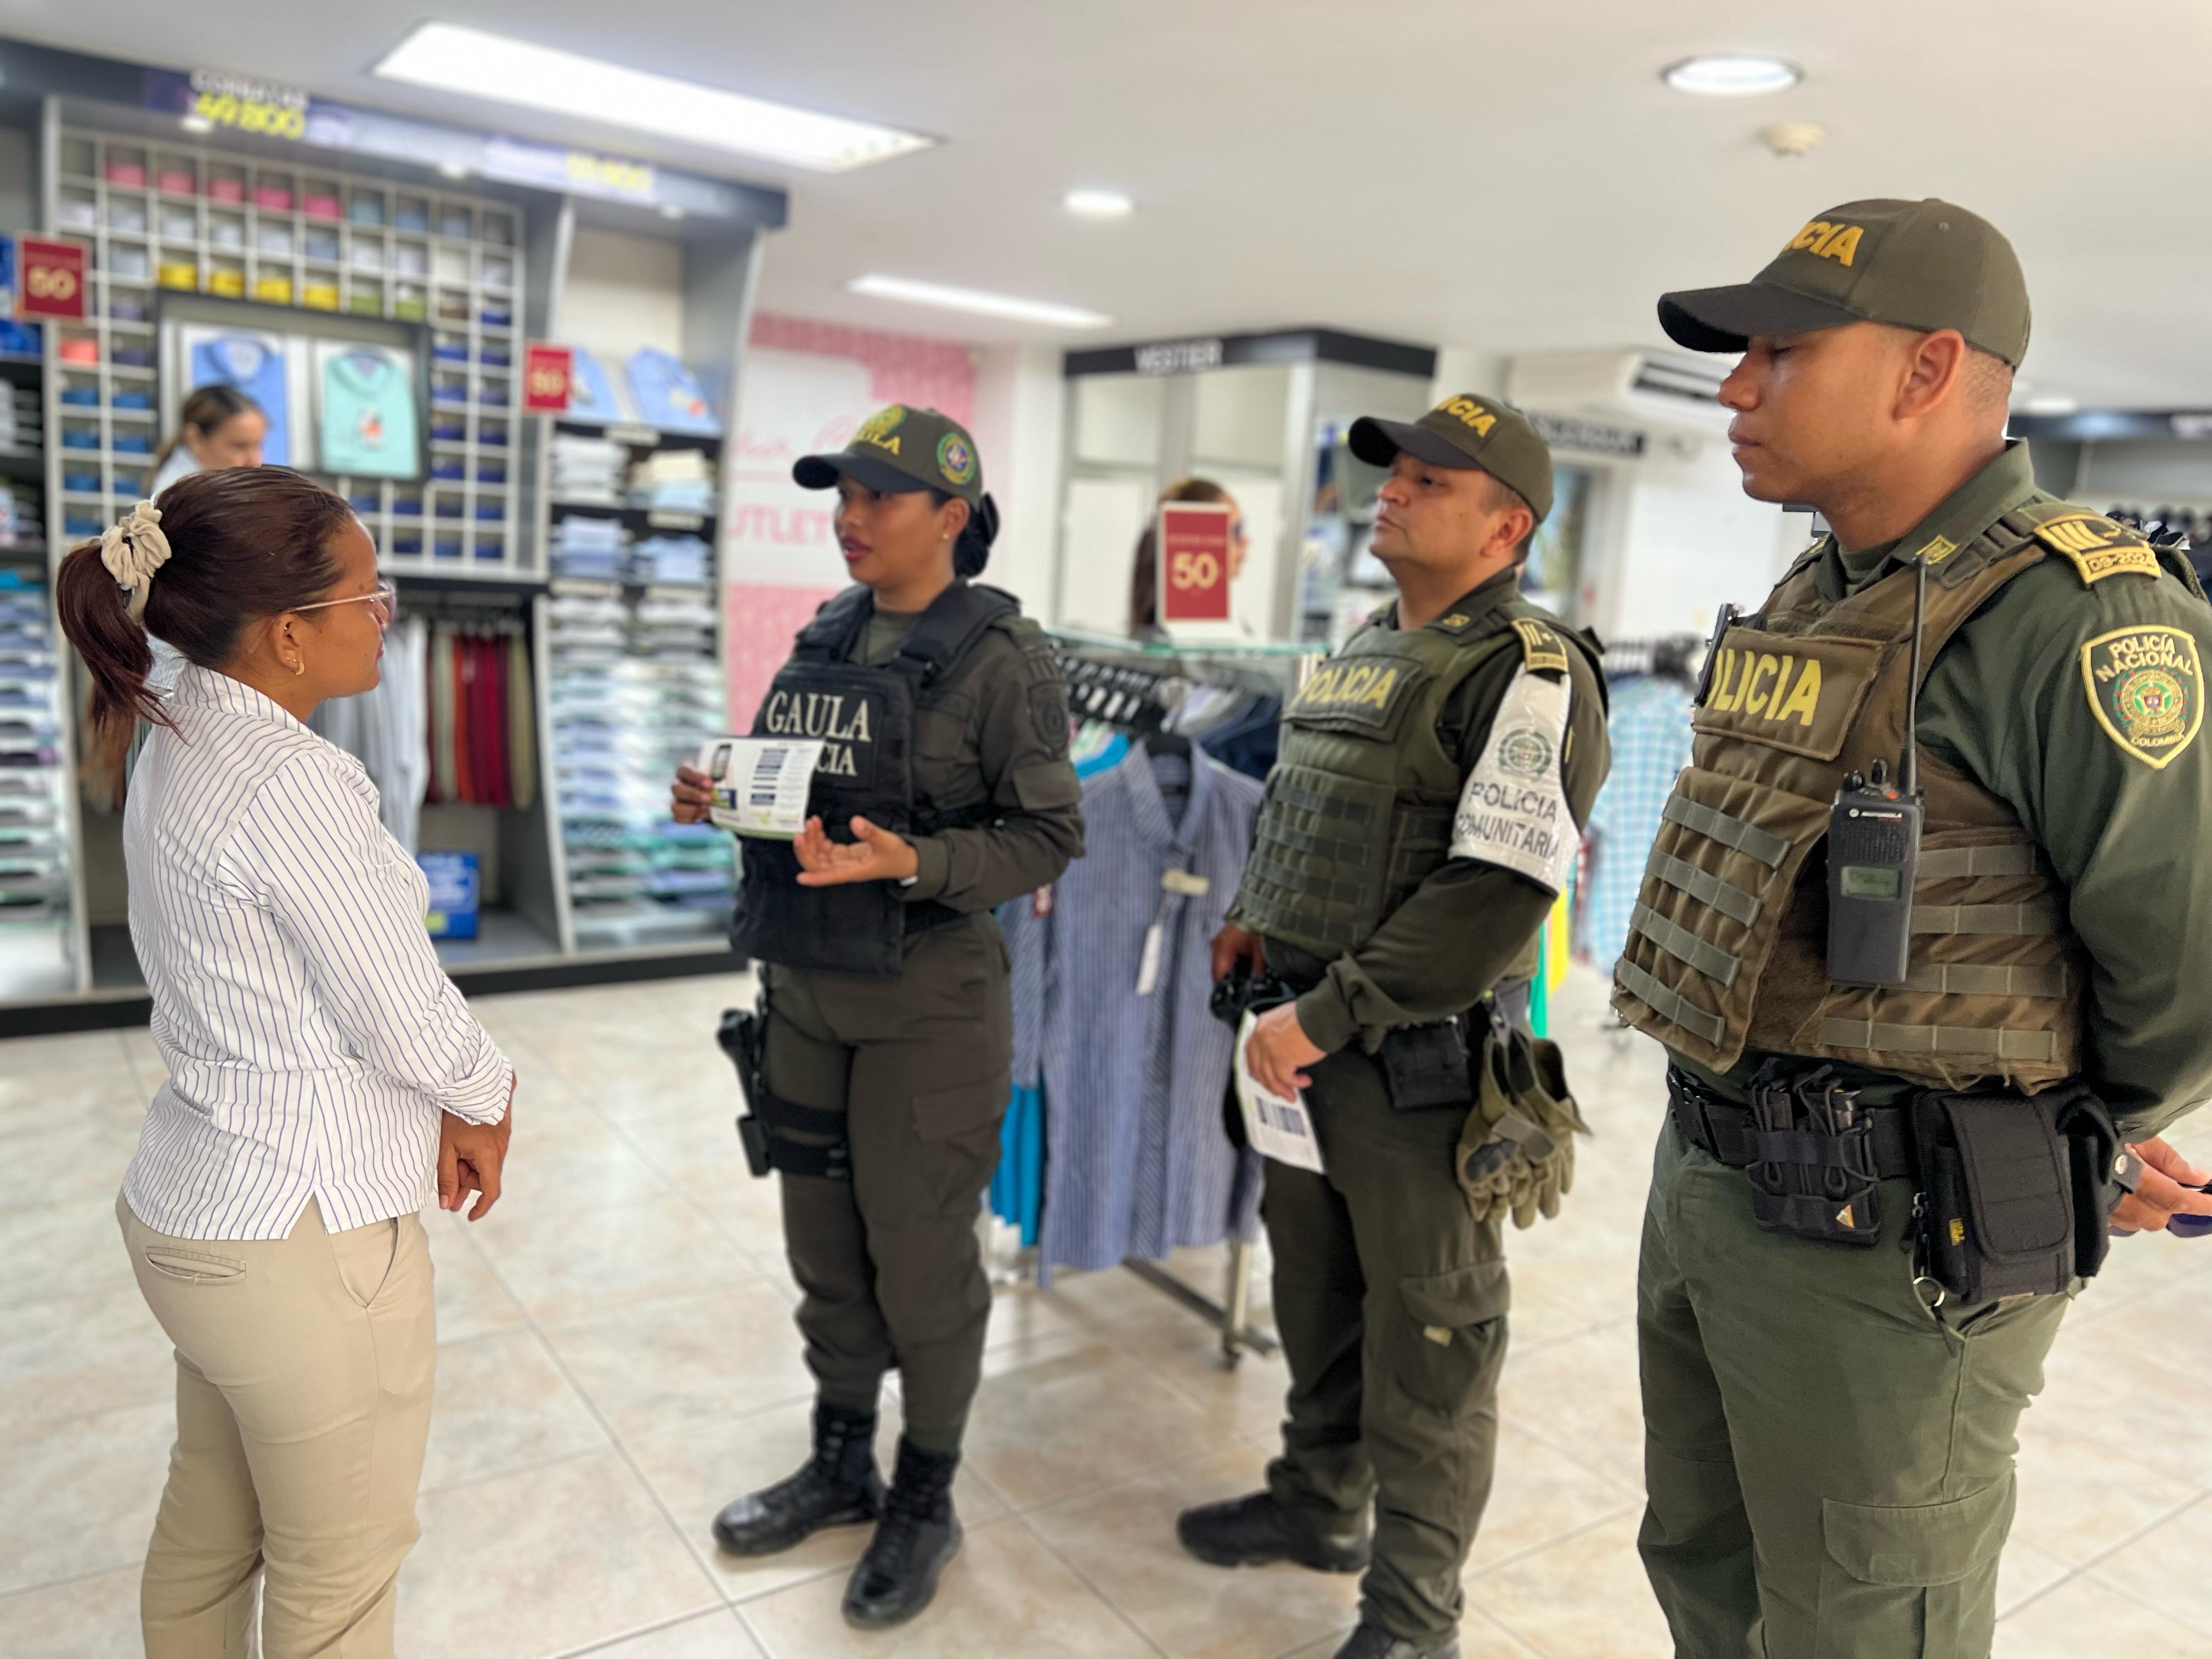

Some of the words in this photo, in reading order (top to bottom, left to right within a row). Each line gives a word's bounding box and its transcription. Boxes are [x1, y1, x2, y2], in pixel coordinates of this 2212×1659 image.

[1782, 221, 1864, 267] ICIA
[1436, 394, 1497, 437] ICIA
[1172, 551, 1218, 590] 50
[1702, 648, 1822, 726] LICIA
[2095, 651, 2193, 682] NACIONAL
[766, 690, 872, 743] GAULA
[816, 742, 858, 777] CIA
[1468, 782, 1557, 823] POLICIA
